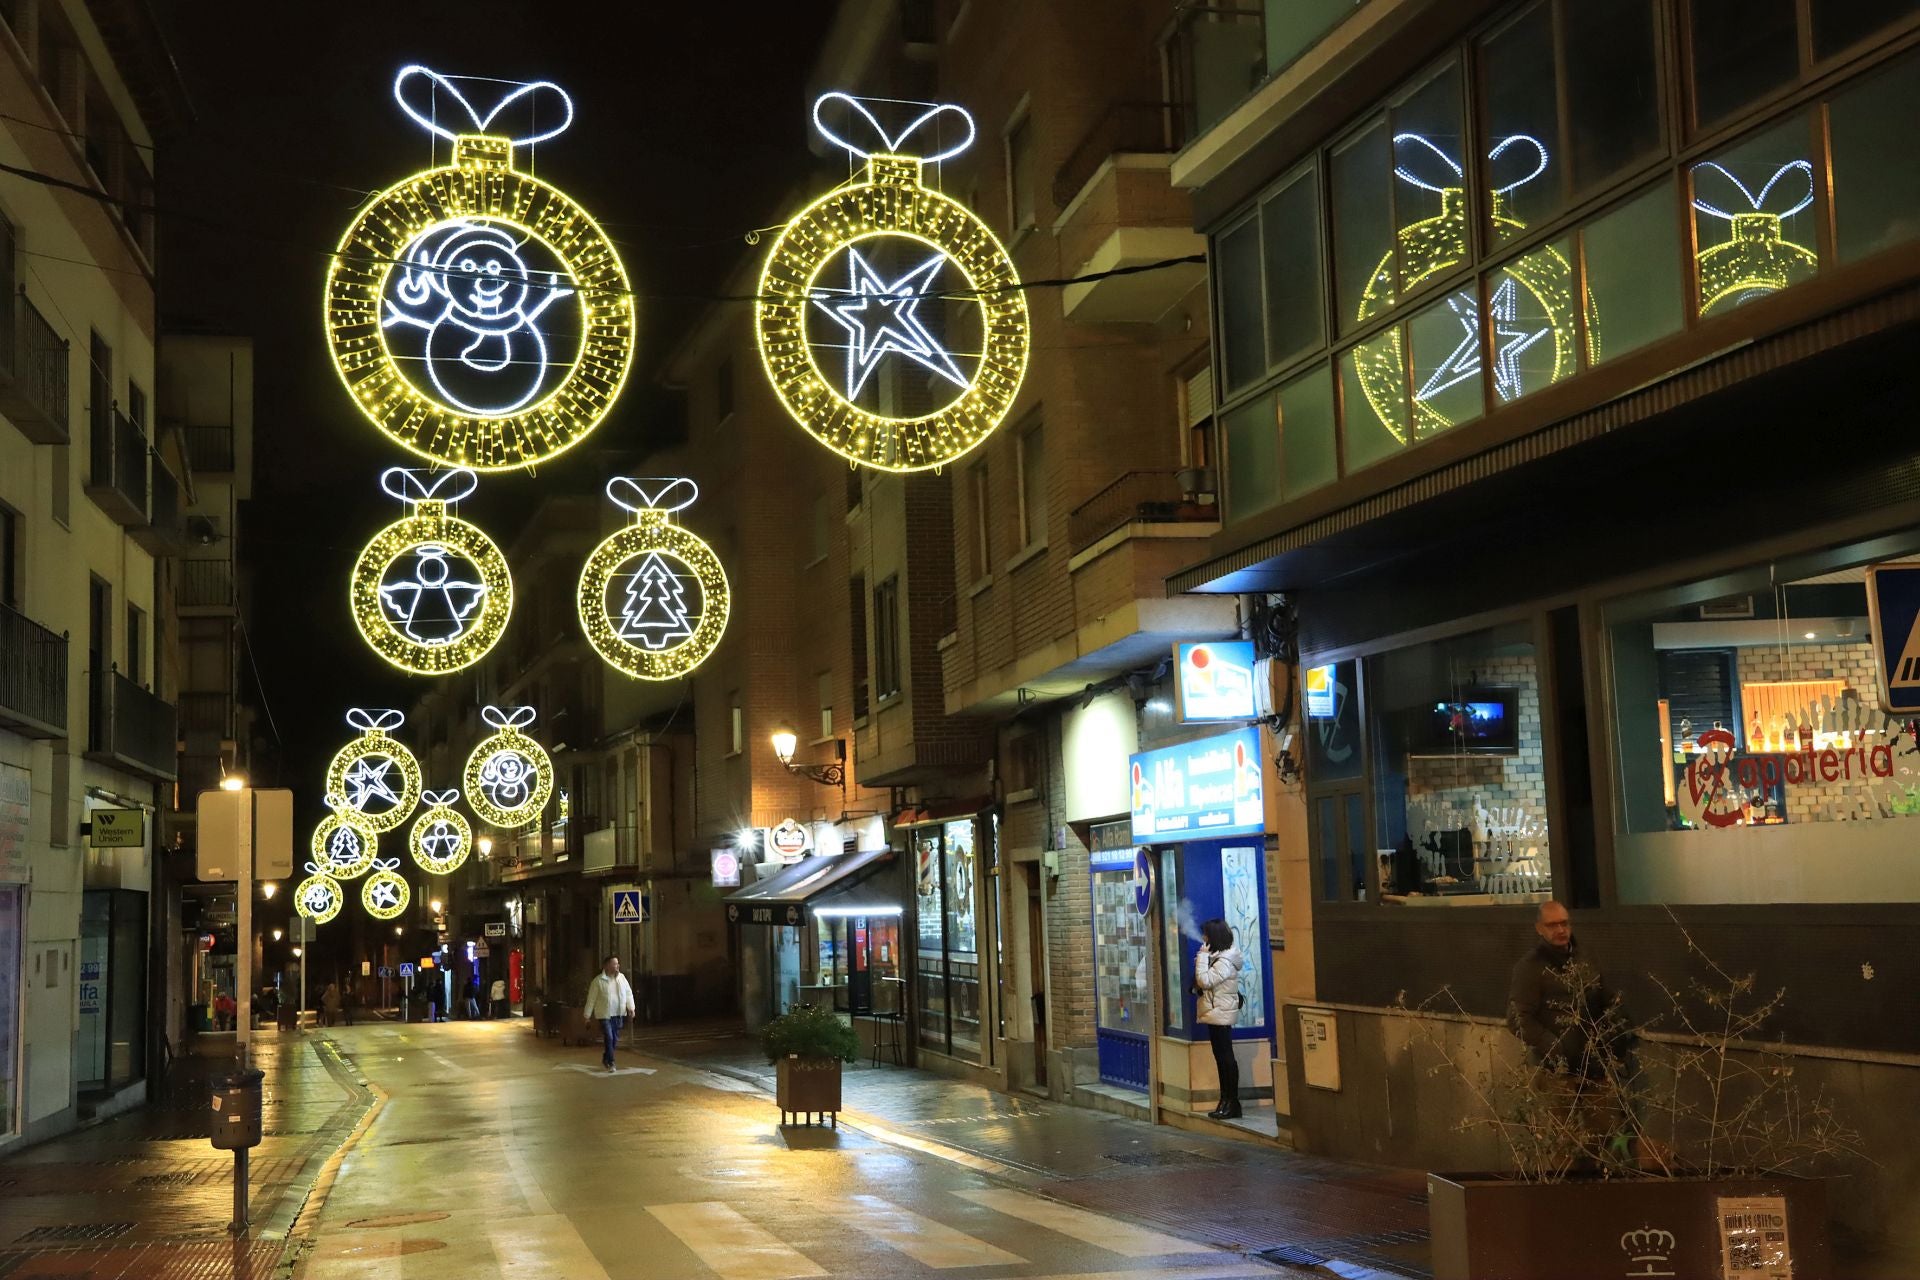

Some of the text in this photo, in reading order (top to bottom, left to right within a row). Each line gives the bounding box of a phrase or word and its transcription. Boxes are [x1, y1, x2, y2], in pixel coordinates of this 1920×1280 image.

[1155, 757, 1185, 810] Alfa
[99, 827, 134, 835] Western
[80, 983, 98, 1000] lfa
